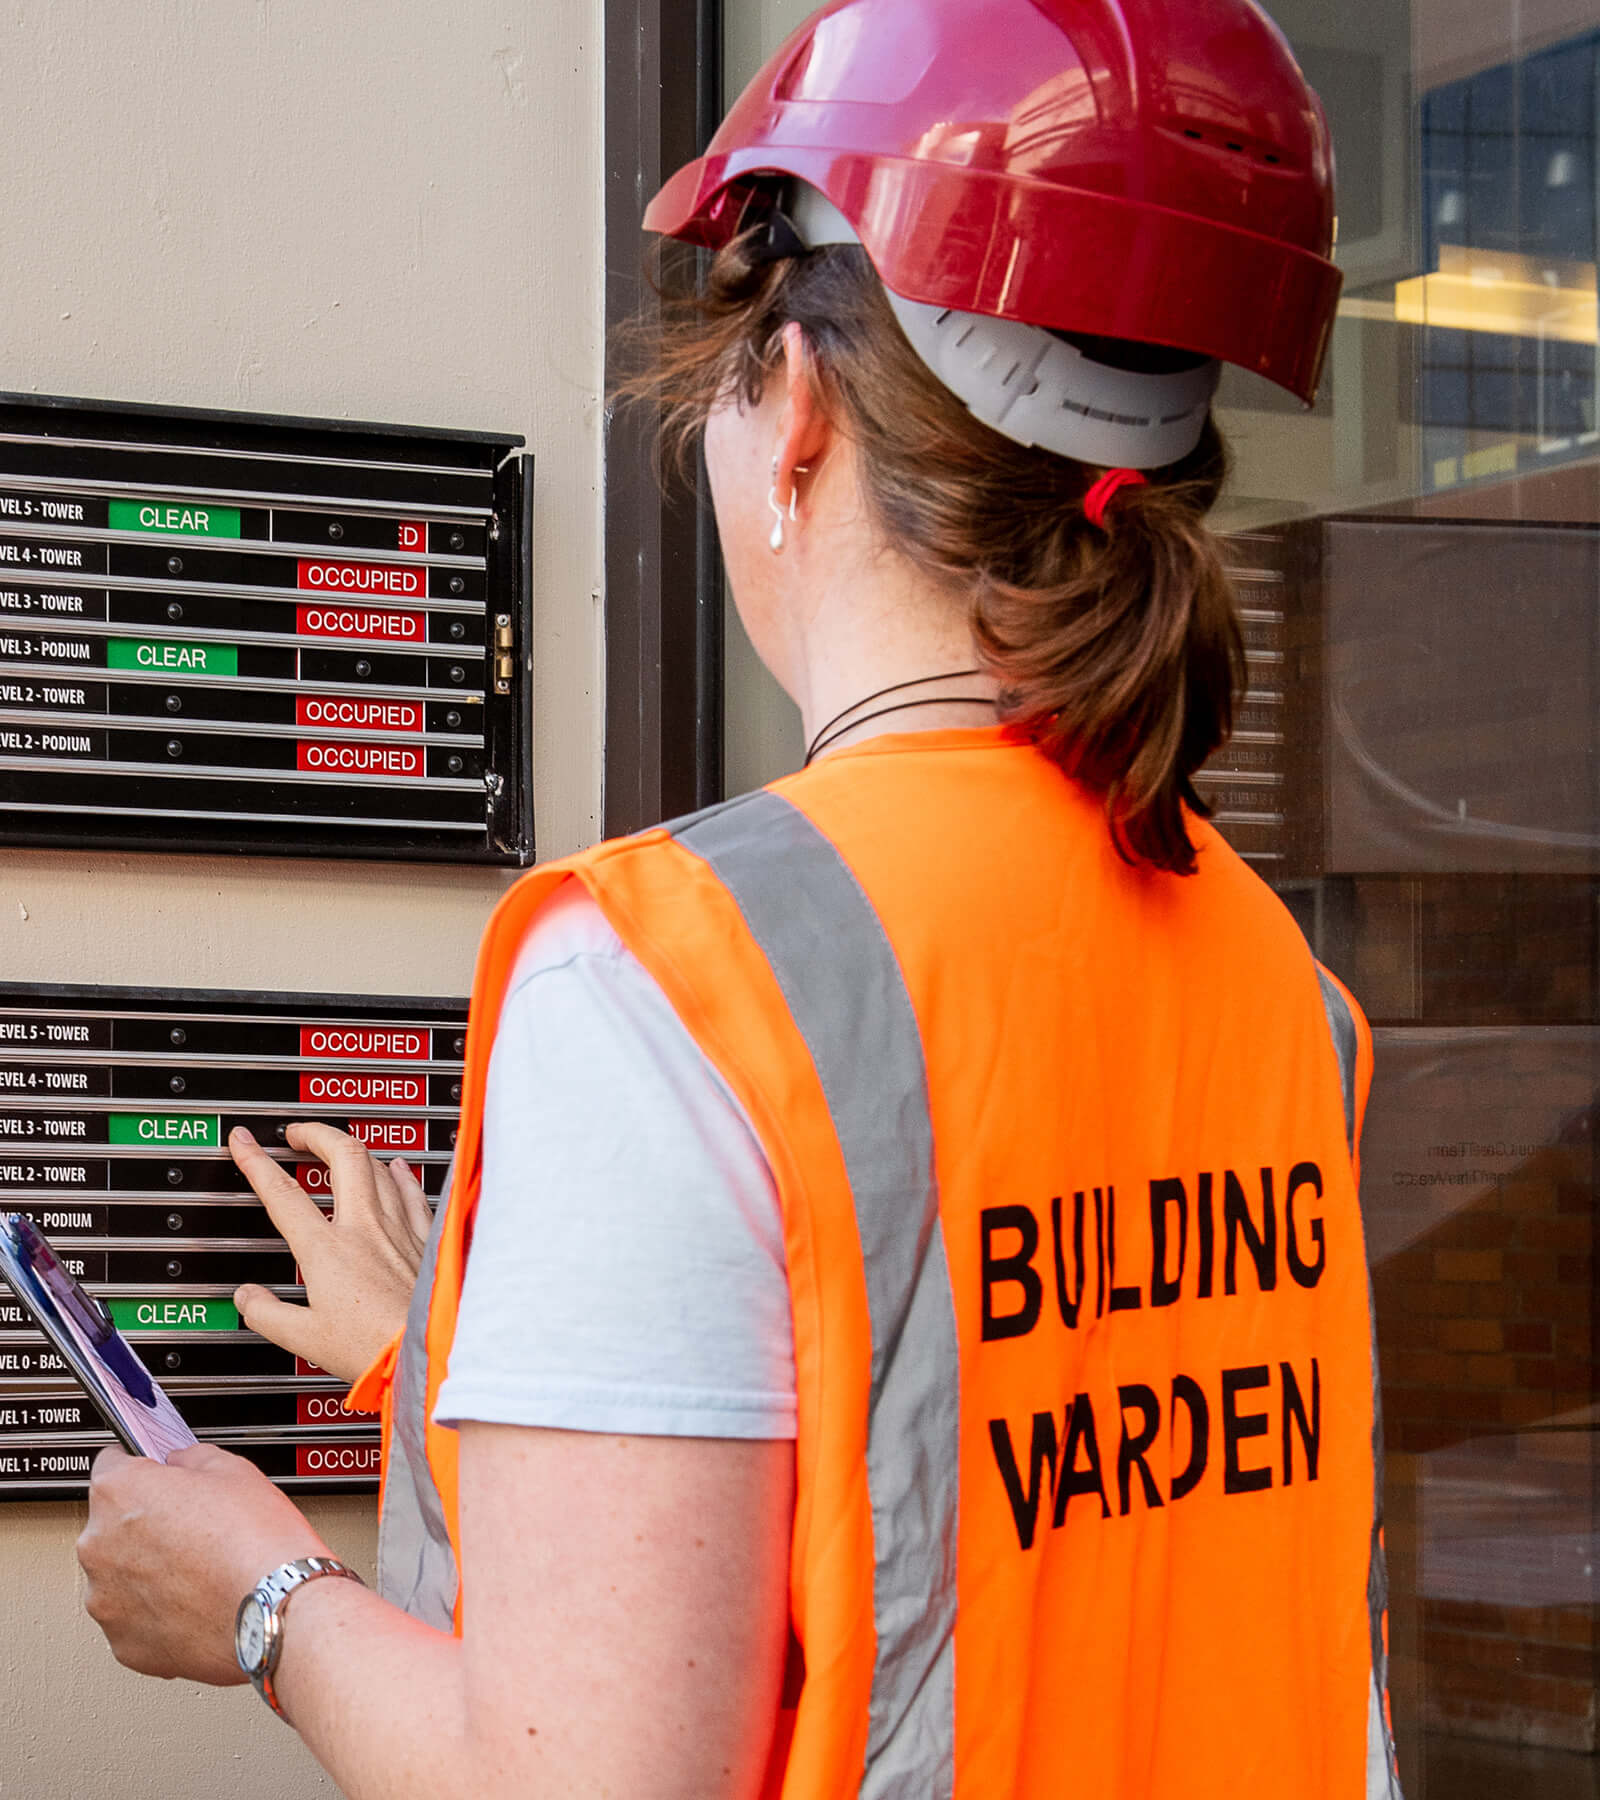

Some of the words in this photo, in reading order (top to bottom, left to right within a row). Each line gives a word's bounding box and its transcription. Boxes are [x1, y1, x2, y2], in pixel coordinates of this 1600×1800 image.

[23, 500, 32, 516] 5
[40, 501, 84, 521] TOWER
[138, 507, 209, 531] CLEAR
[21, 547, 31, 563] 4
[38, 547, 82, 567] TOWER
[307, 565, 418, 592] OCCUPIED
[23, 593, 32, 609] 3
[39, 594, 83, 612] TOWER
[305, 610, 416, 636] OCCUPIED
[23, 640, 32, 656] 3
[41, 640, 91, 660] PODIUM
[136, 645, 207, 669] CLEAR
[25, 687, 34, 702] 2
[42, 687, 86, 705] TOWER
[305, 701, 416, 726] OCCUPIED
[24, 734, 33, 749] 2
[42, 734, 91, 753] PODIUM
[306, 746, 416, 771] OCCUPIED
[29, 1025, 38, 1040] 5
[46, 1025, 90, 1042] TOWER
[310, 1031, 420, 1054] OCCUPIED
[27, 1072, 37, 1088] 4
[44, 1072, 88, 1089] TOWER
[309, 1077, 419, 1100] OCCUPIED
[26, 1120, 35, 1135] 3
[43, 1120, 86, 1137] TOWER
[138, 1119, 208, 1140] CLEAR
[26, 1166, 35, 1182] 2
[43, 1166, 86, 1183] TOWER
[43, 1212, 93, 1228] PODIUM
[980, 1161, 1326, 1343] BUILDING
[136, 1304, 207, 1324] CLEAR
[21, 1354, 30, 1370] 0
[21, 1409, 28, 1425] 1
[37, 1407, 81, 1424] TOWER
[22, 1457, 30, 1473] 1
[40, 1455, 90, 1472] PODIUM
[988, 1357, 1320, 1551] WARDEN
